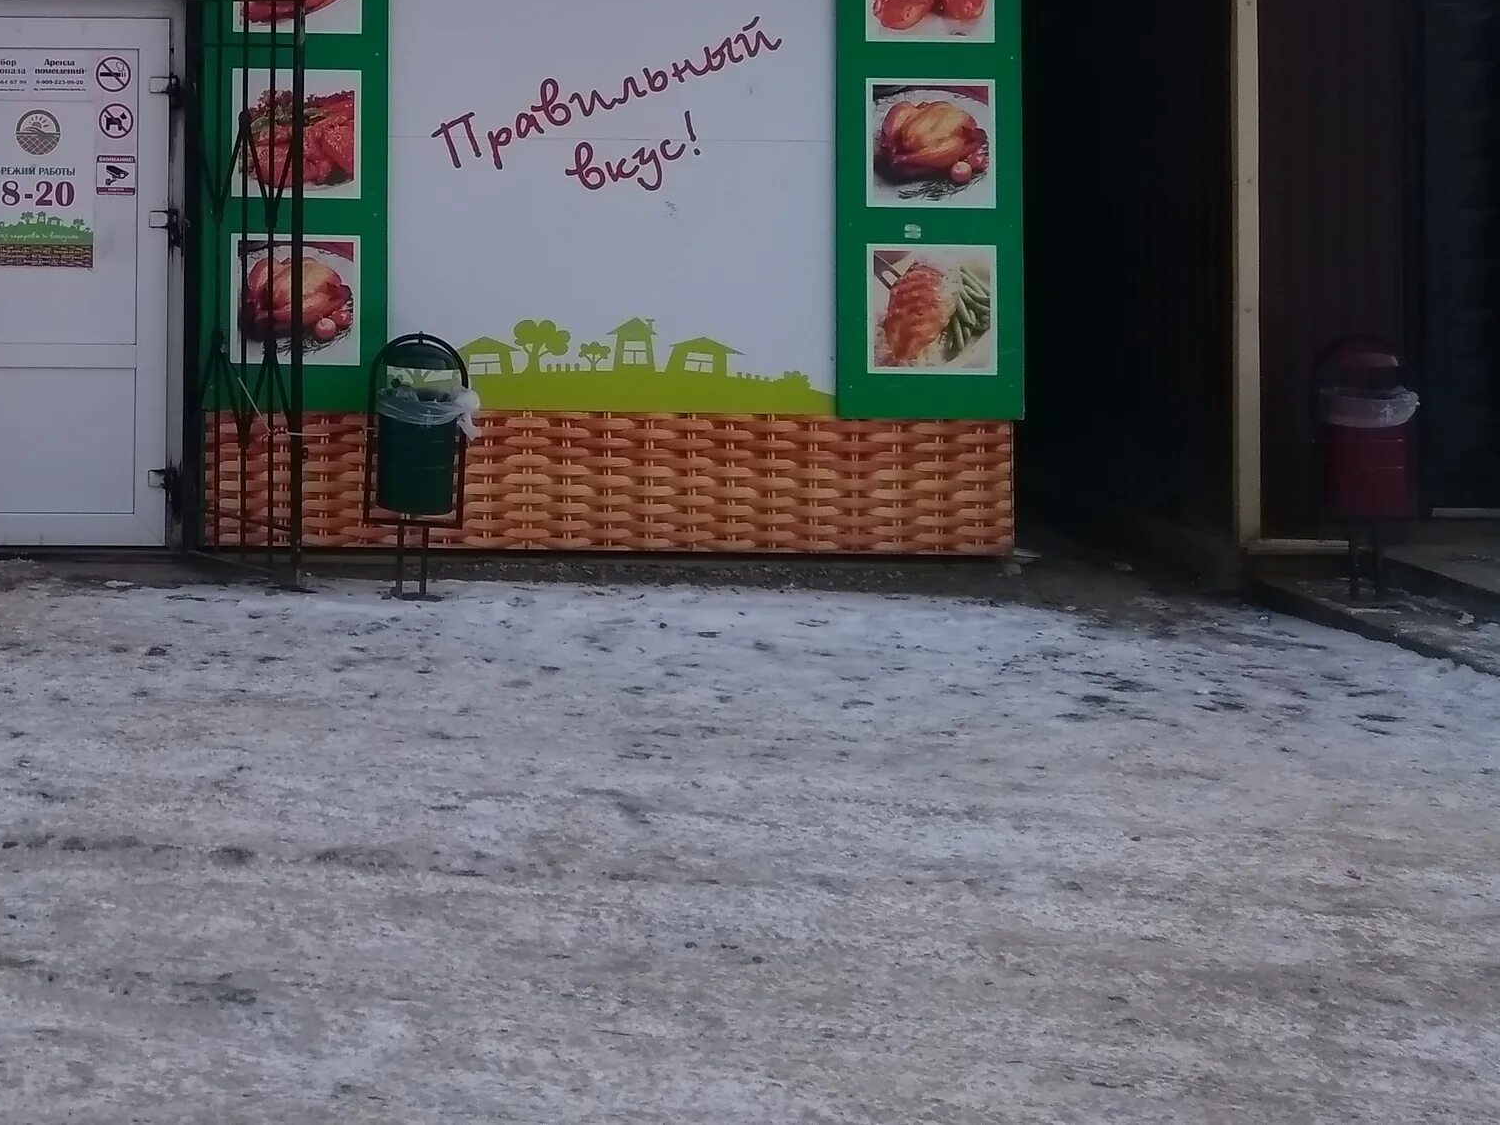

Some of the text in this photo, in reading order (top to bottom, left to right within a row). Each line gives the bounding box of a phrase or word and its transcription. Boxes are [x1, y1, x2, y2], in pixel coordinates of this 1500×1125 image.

[35, 67, 85, 75] помещений
[44, 58, 75, 67] Аренда
[431, 16, 782, 170] Правильный
[565, 110, 701, 191] вкус!
[0, 166, 76, 176] РЕЖИМ РАБОТЫ
[1, 180, 75, 207] 8-20
